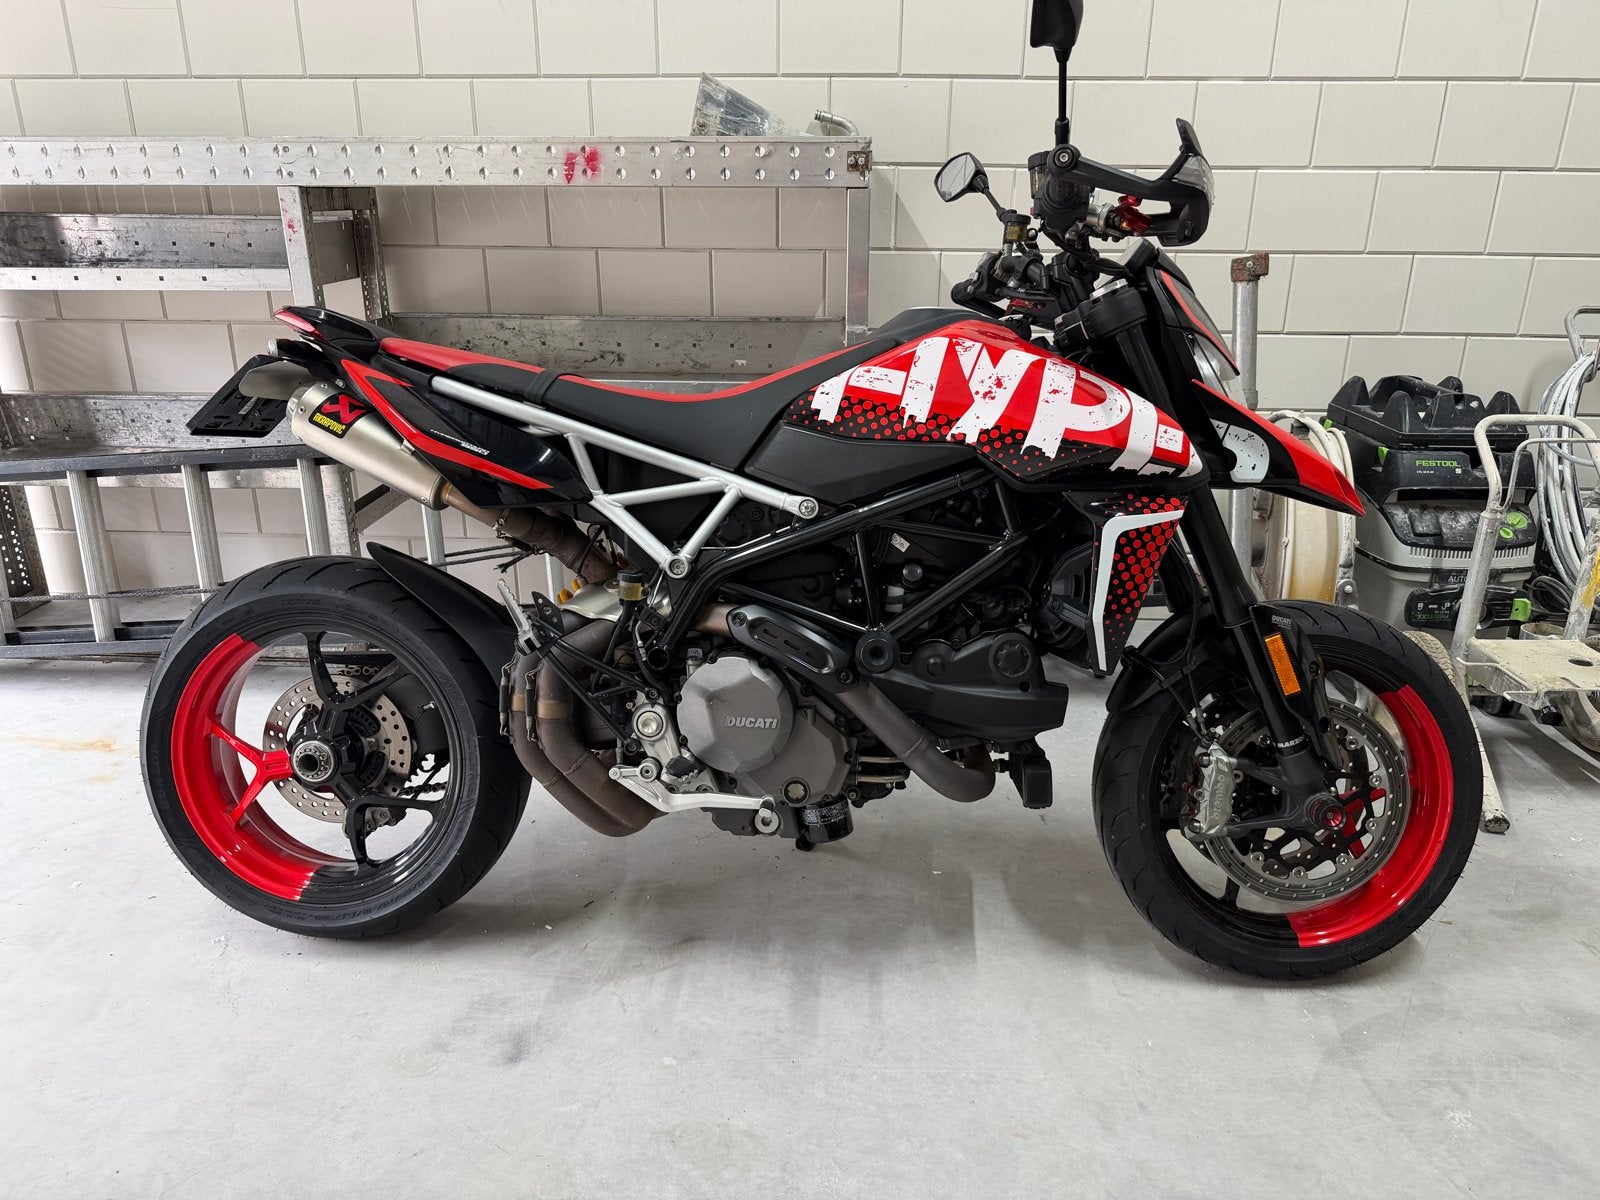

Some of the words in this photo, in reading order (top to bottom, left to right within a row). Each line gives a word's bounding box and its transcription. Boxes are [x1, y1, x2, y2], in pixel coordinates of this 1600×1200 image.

[1271, 614, 1292, 625] DUCATI
[724, 716, 778, 729] DUCATI
[1211, 775, 1225, 821] brembo
